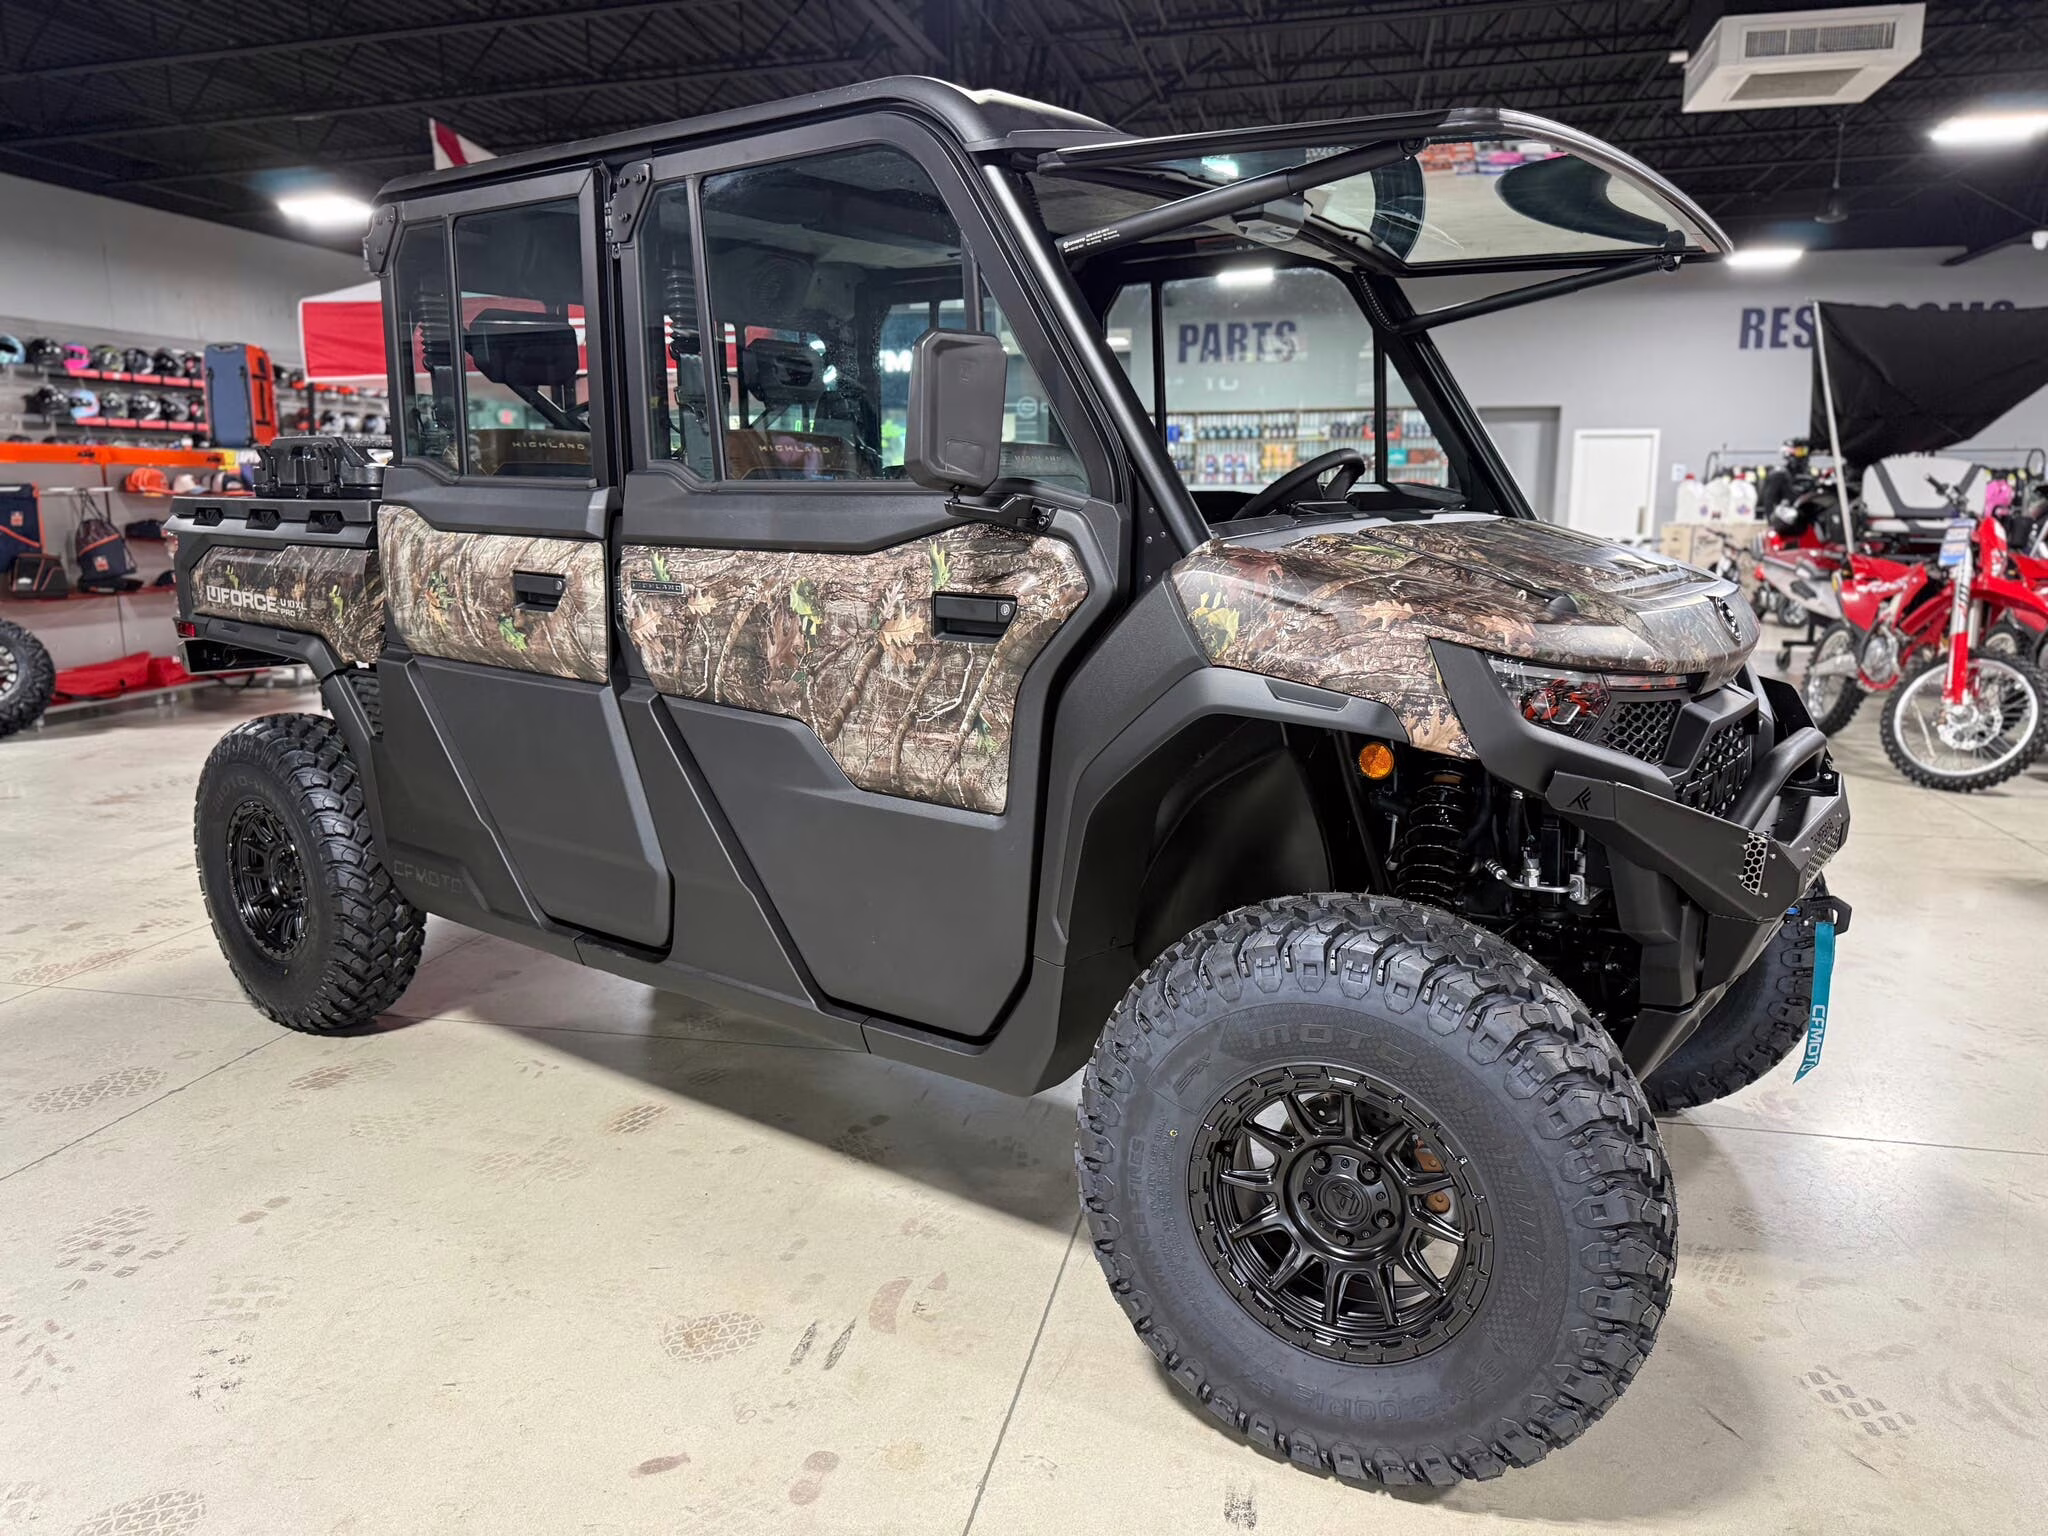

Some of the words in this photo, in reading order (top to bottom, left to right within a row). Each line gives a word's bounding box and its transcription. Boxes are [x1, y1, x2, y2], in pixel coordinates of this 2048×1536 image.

[1178, 321, 1297, 363] PARTS
[511, 441, 585, 450] HIGHLAND
[281, 608, 296, 617] PRO
[393, 860, 464, 894] CFMOTO
